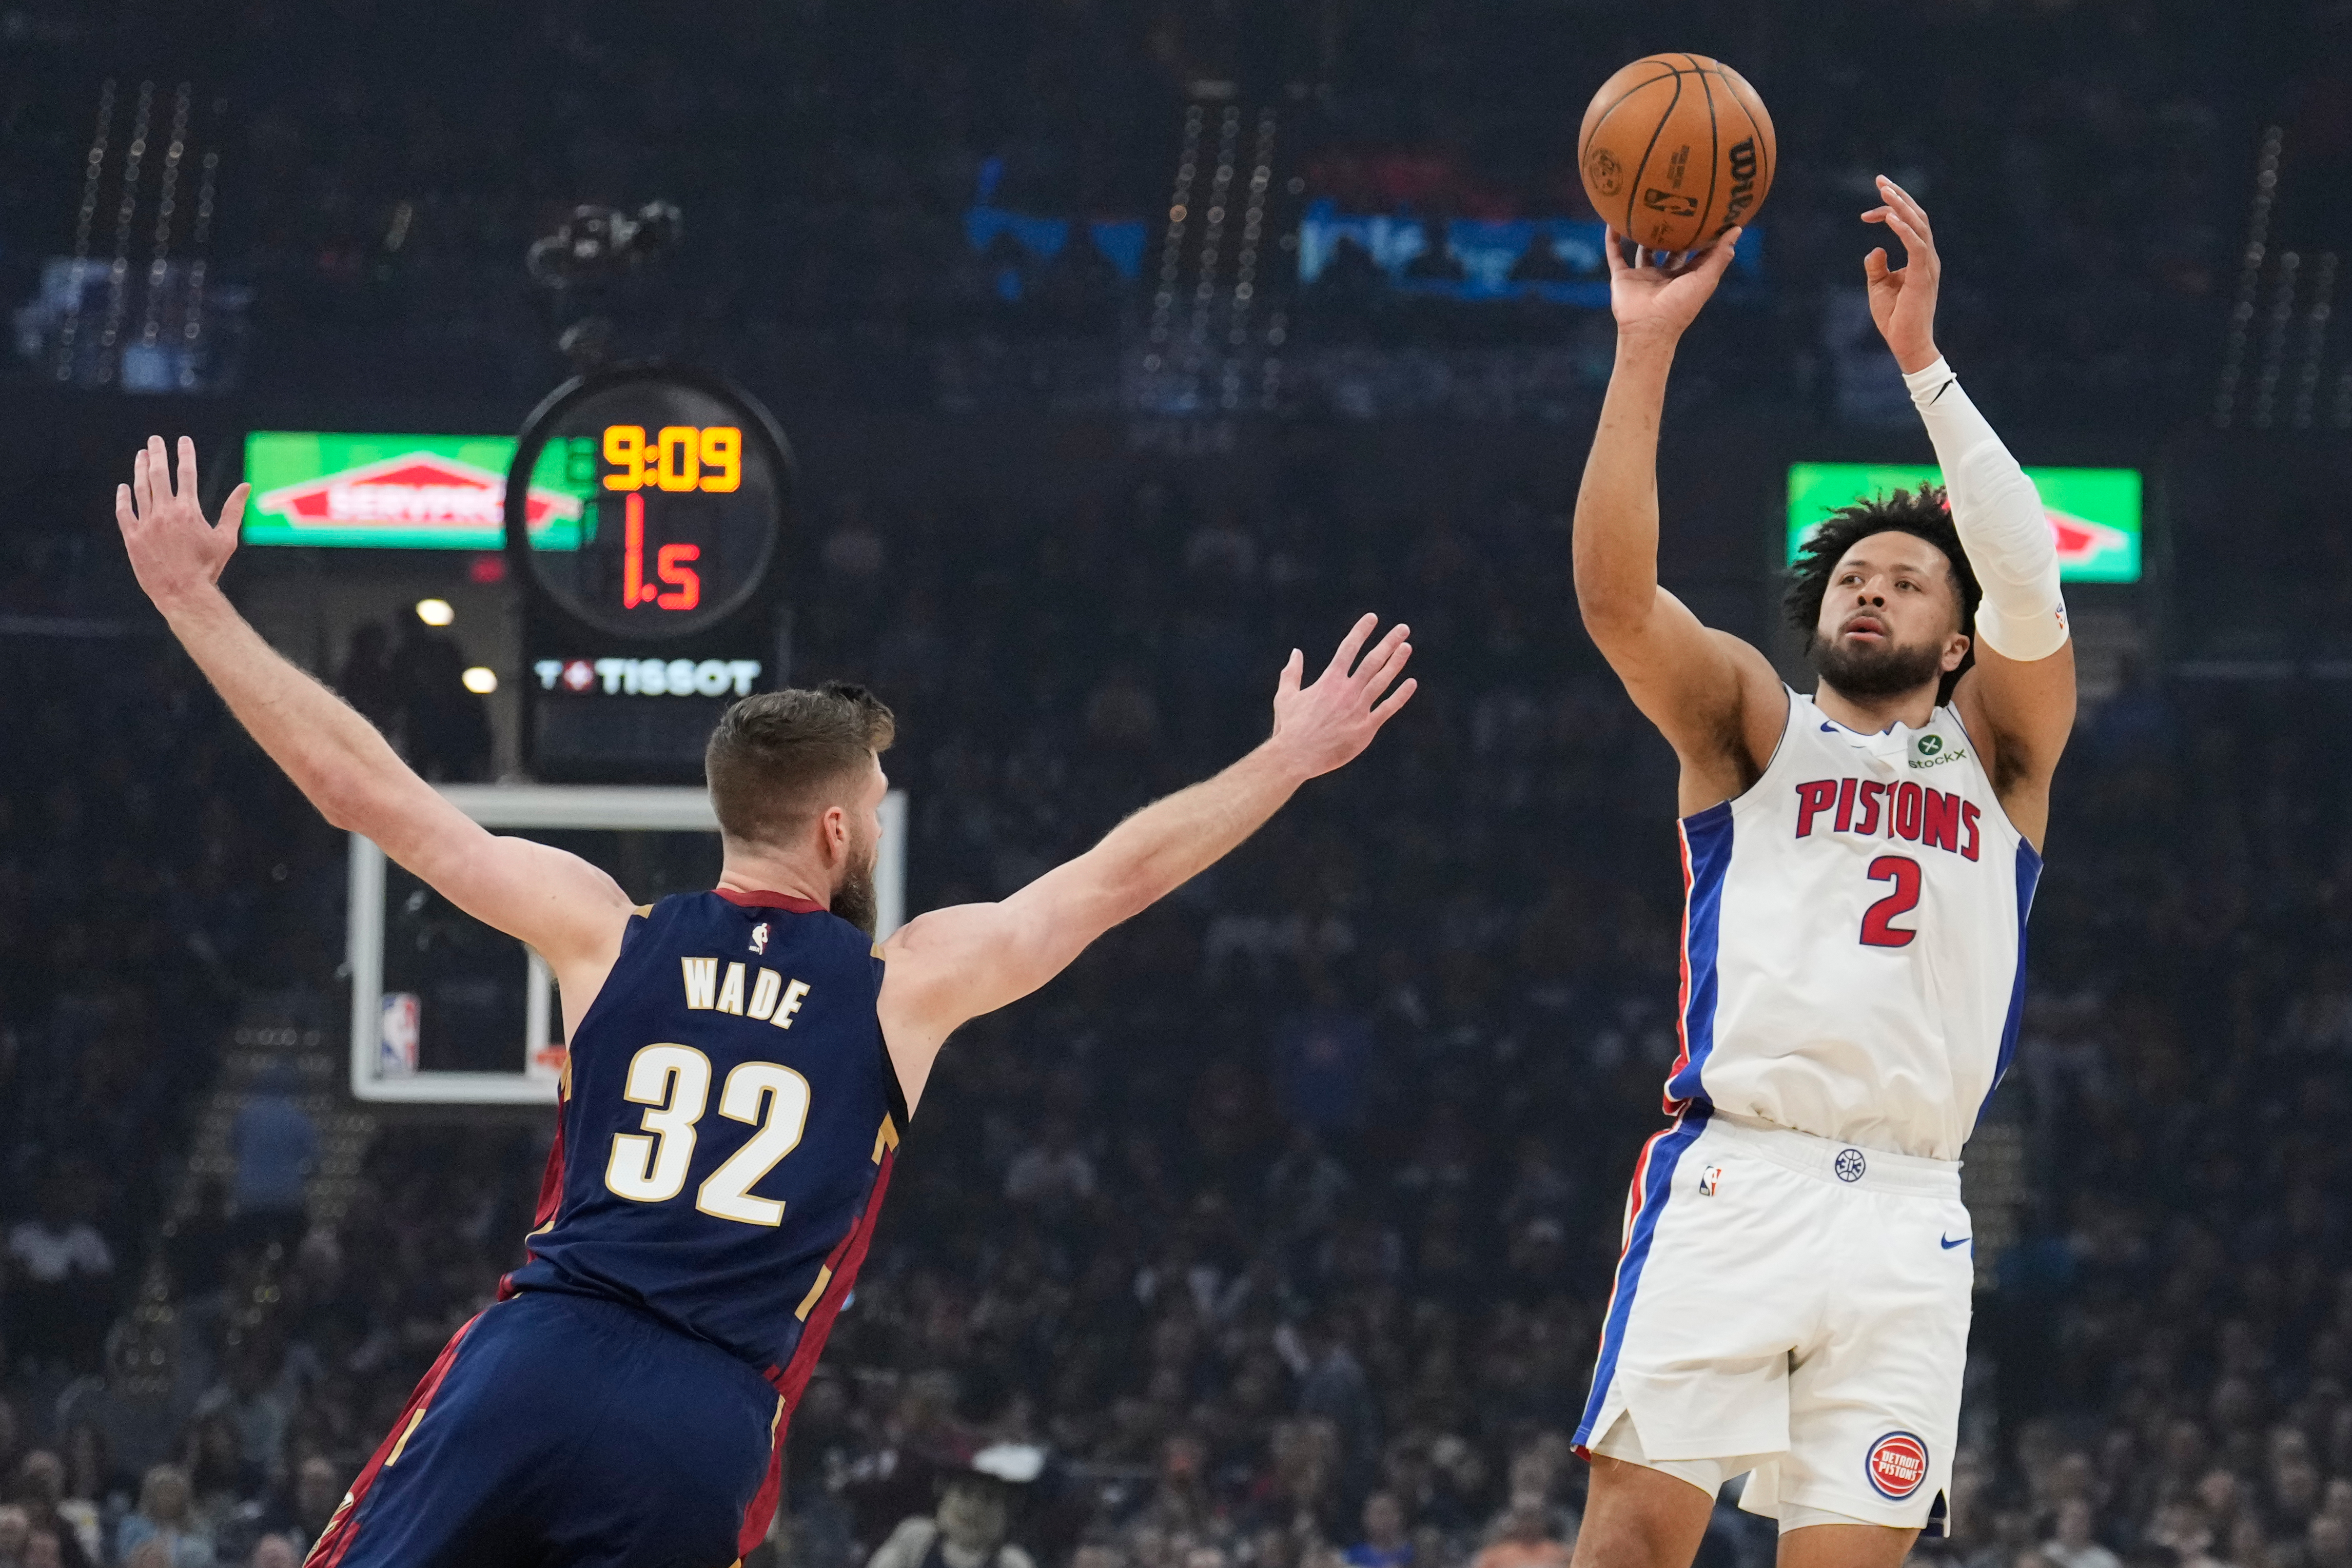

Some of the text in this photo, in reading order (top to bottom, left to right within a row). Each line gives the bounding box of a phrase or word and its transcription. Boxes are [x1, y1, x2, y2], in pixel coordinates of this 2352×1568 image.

[1714, 134, 1757, 240] Wils
[603, 425, 742, 493] 9:09
[623, 493, 700, 610] 1.5
[595, 658, 762, 697] TISSOT
[1795, 777, 1981, 863] PISTONS
[1859, 855, 1922, 948] 2
[680, 956, 811, 1029] WADE
[604, 1043, 811, 1227] 32
[1878, 1461, 1918, 1481] PISTONS
[1881, 1450, 1920, 1470] DETROIT
